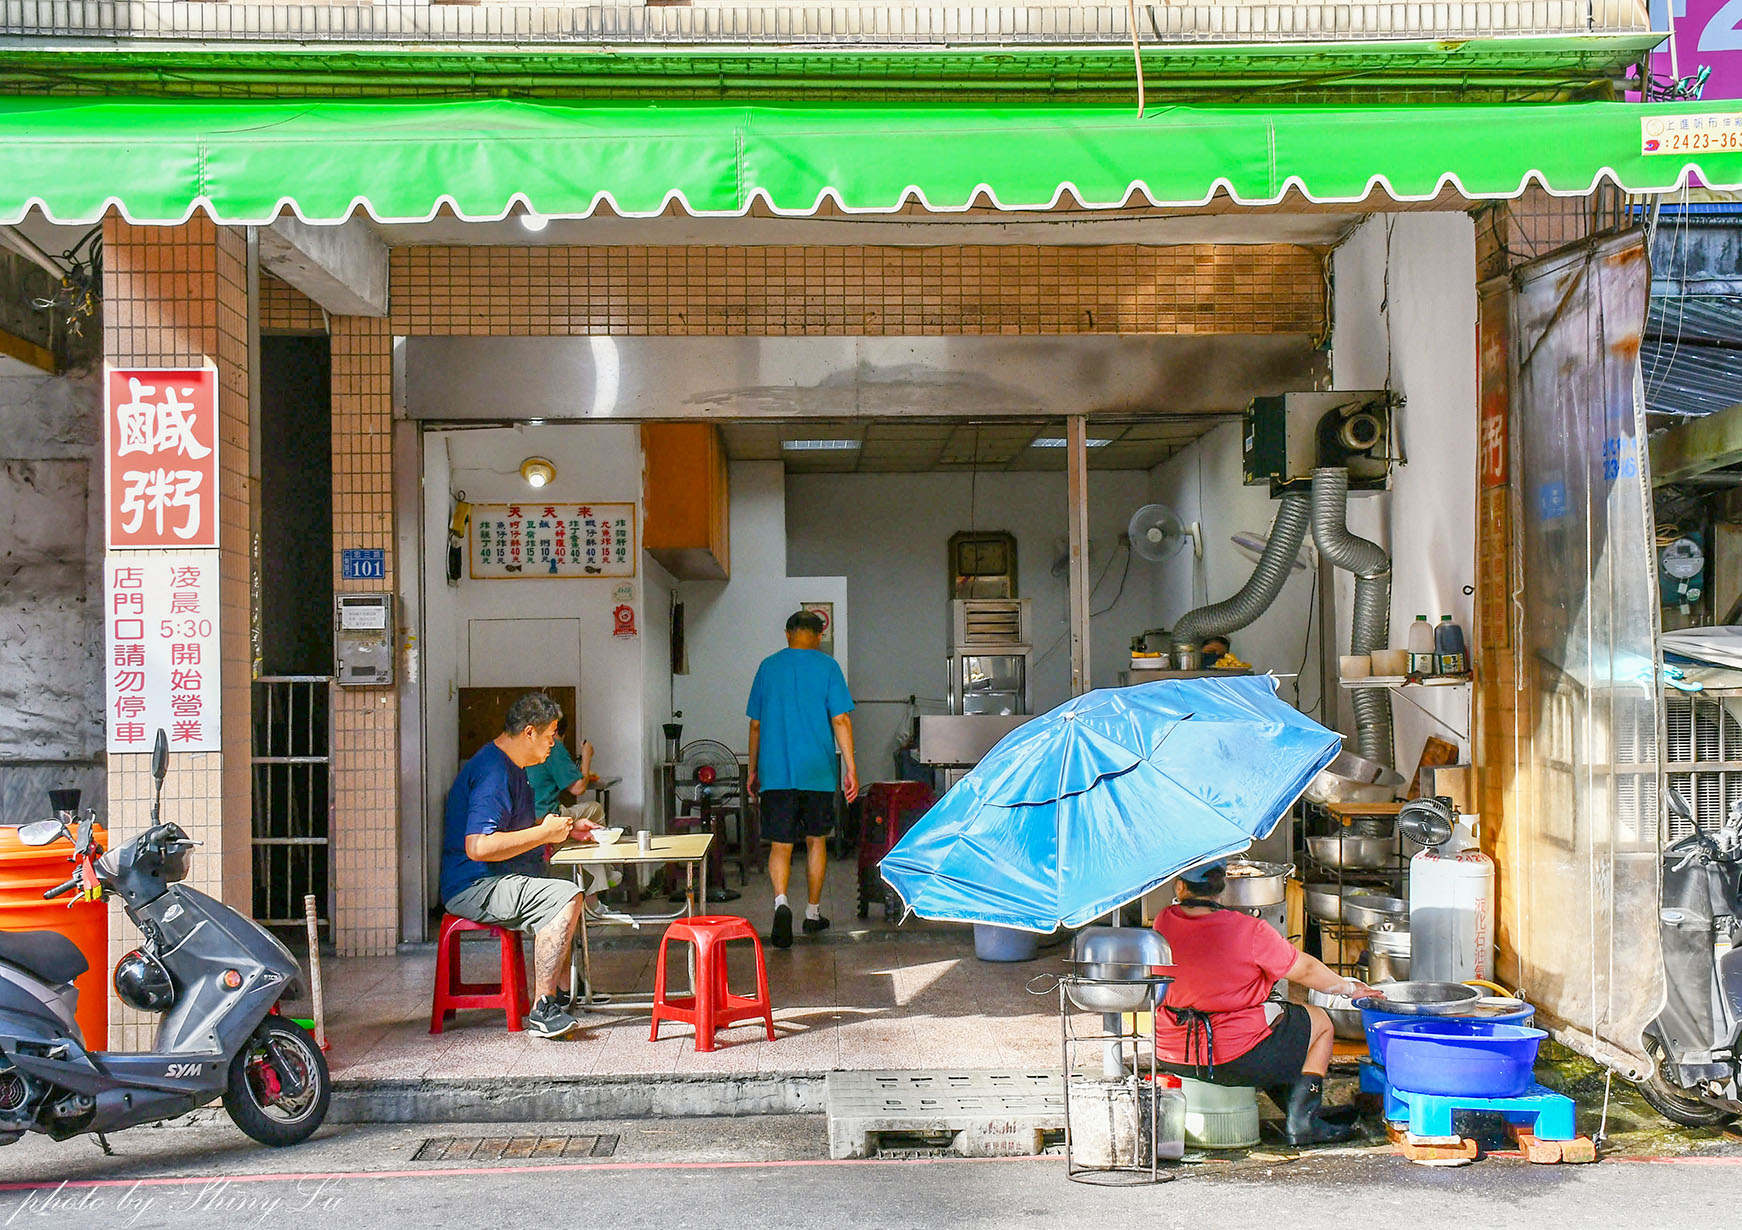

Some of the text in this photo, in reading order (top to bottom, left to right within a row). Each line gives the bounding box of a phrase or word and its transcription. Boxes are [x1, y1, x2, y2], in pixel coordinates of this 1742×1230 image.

[117, 377, 212, 539] 鹹粥
[507, 506, 593, 518] 天天來
[353, 560, 382, 577] 101
[113, 566, 147, 743] 店門口請勿停車
[164, 1063, 203, 1079] SYM
